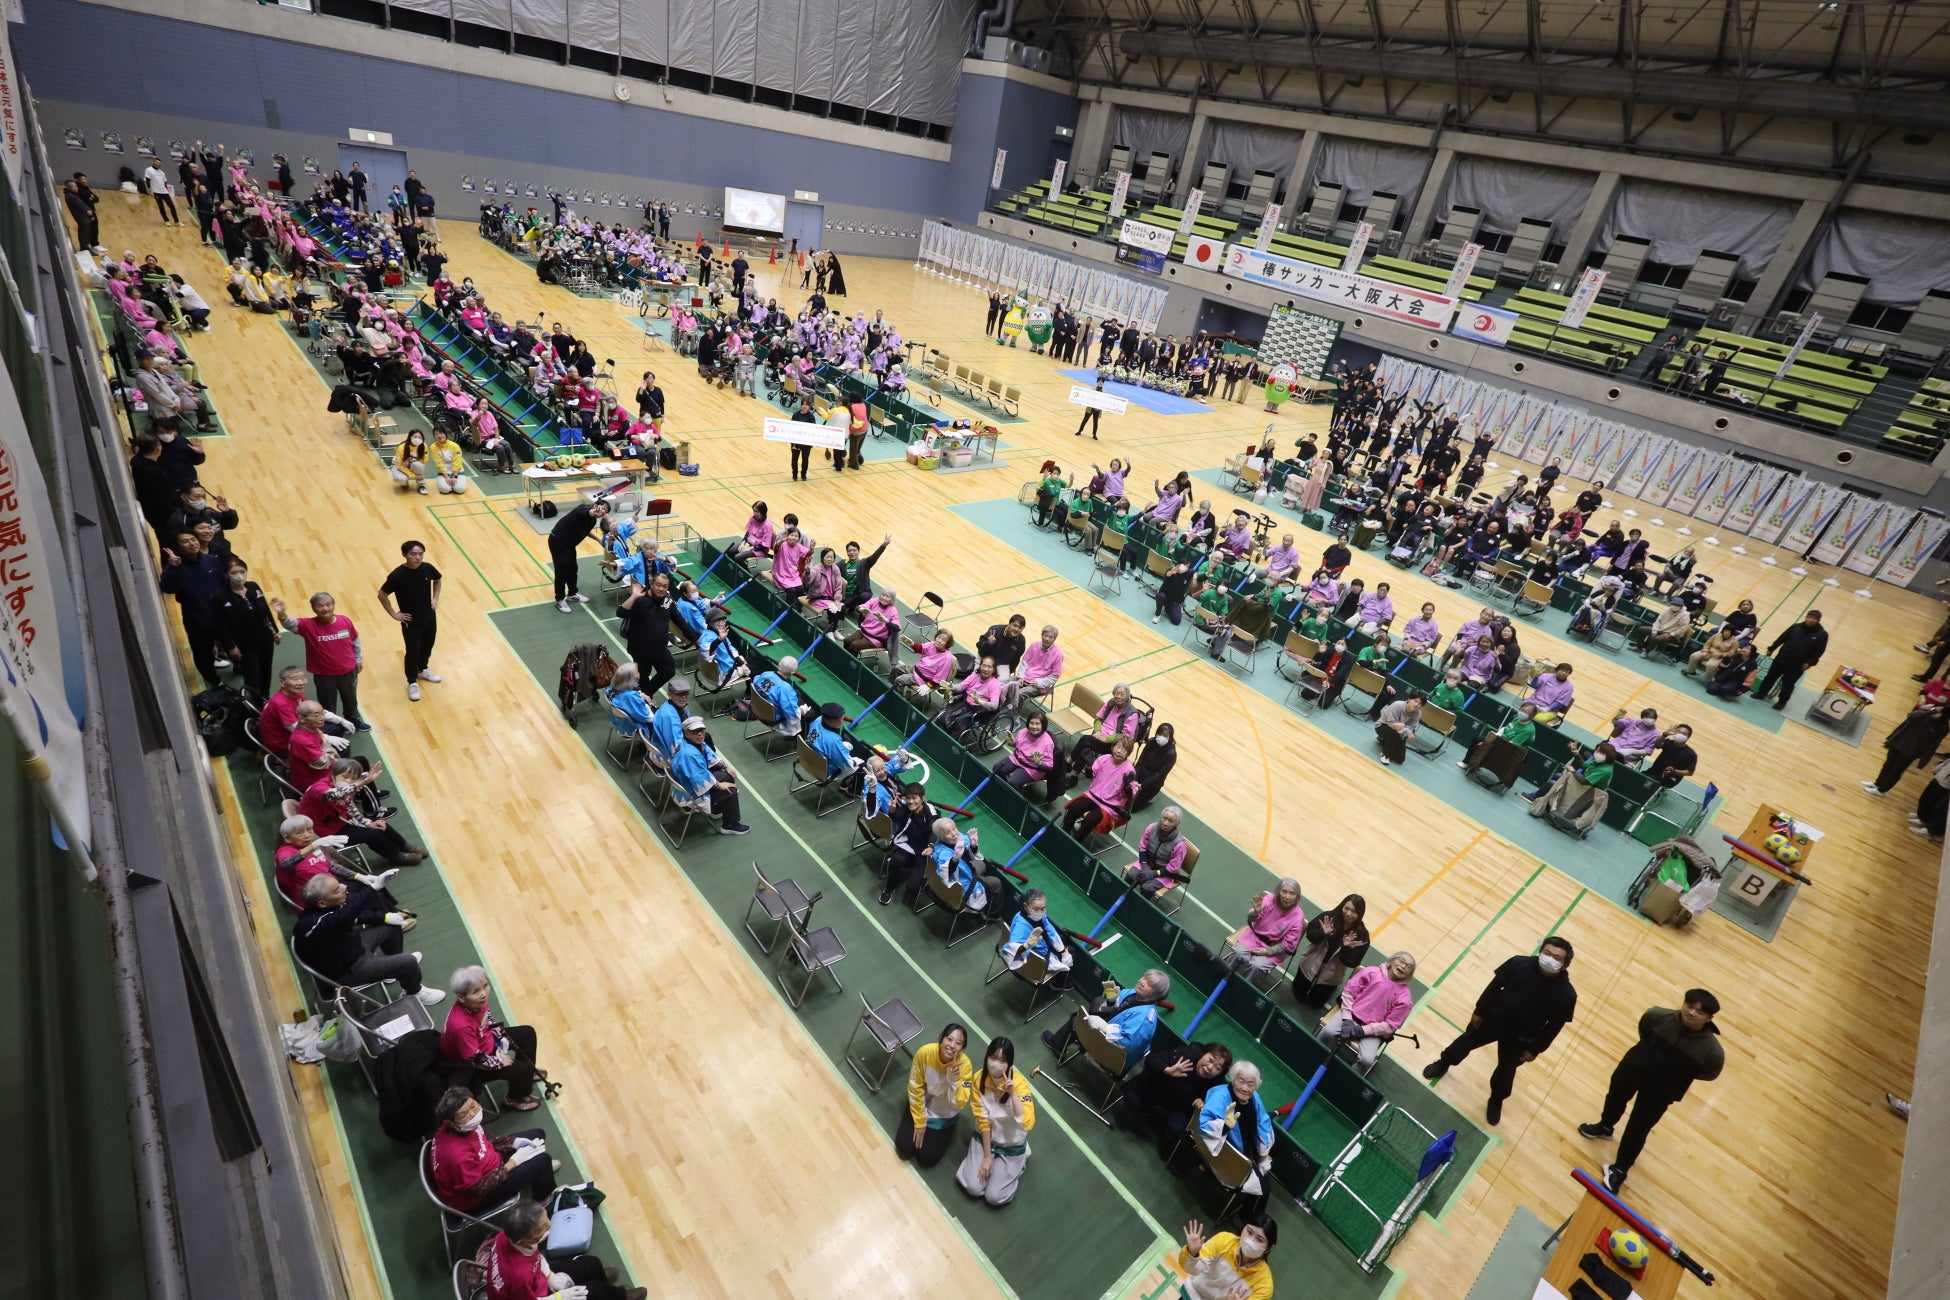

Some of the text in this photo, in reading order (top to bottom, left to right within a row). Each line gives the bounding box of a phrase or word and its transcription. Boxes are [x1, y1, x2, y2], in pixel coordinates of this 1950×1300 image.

[1262, 261, 1425, 316] 棒サッカー大阪大会
[1830, 699, 1848, 713] C
[1740, 874, 1765, 896] B
